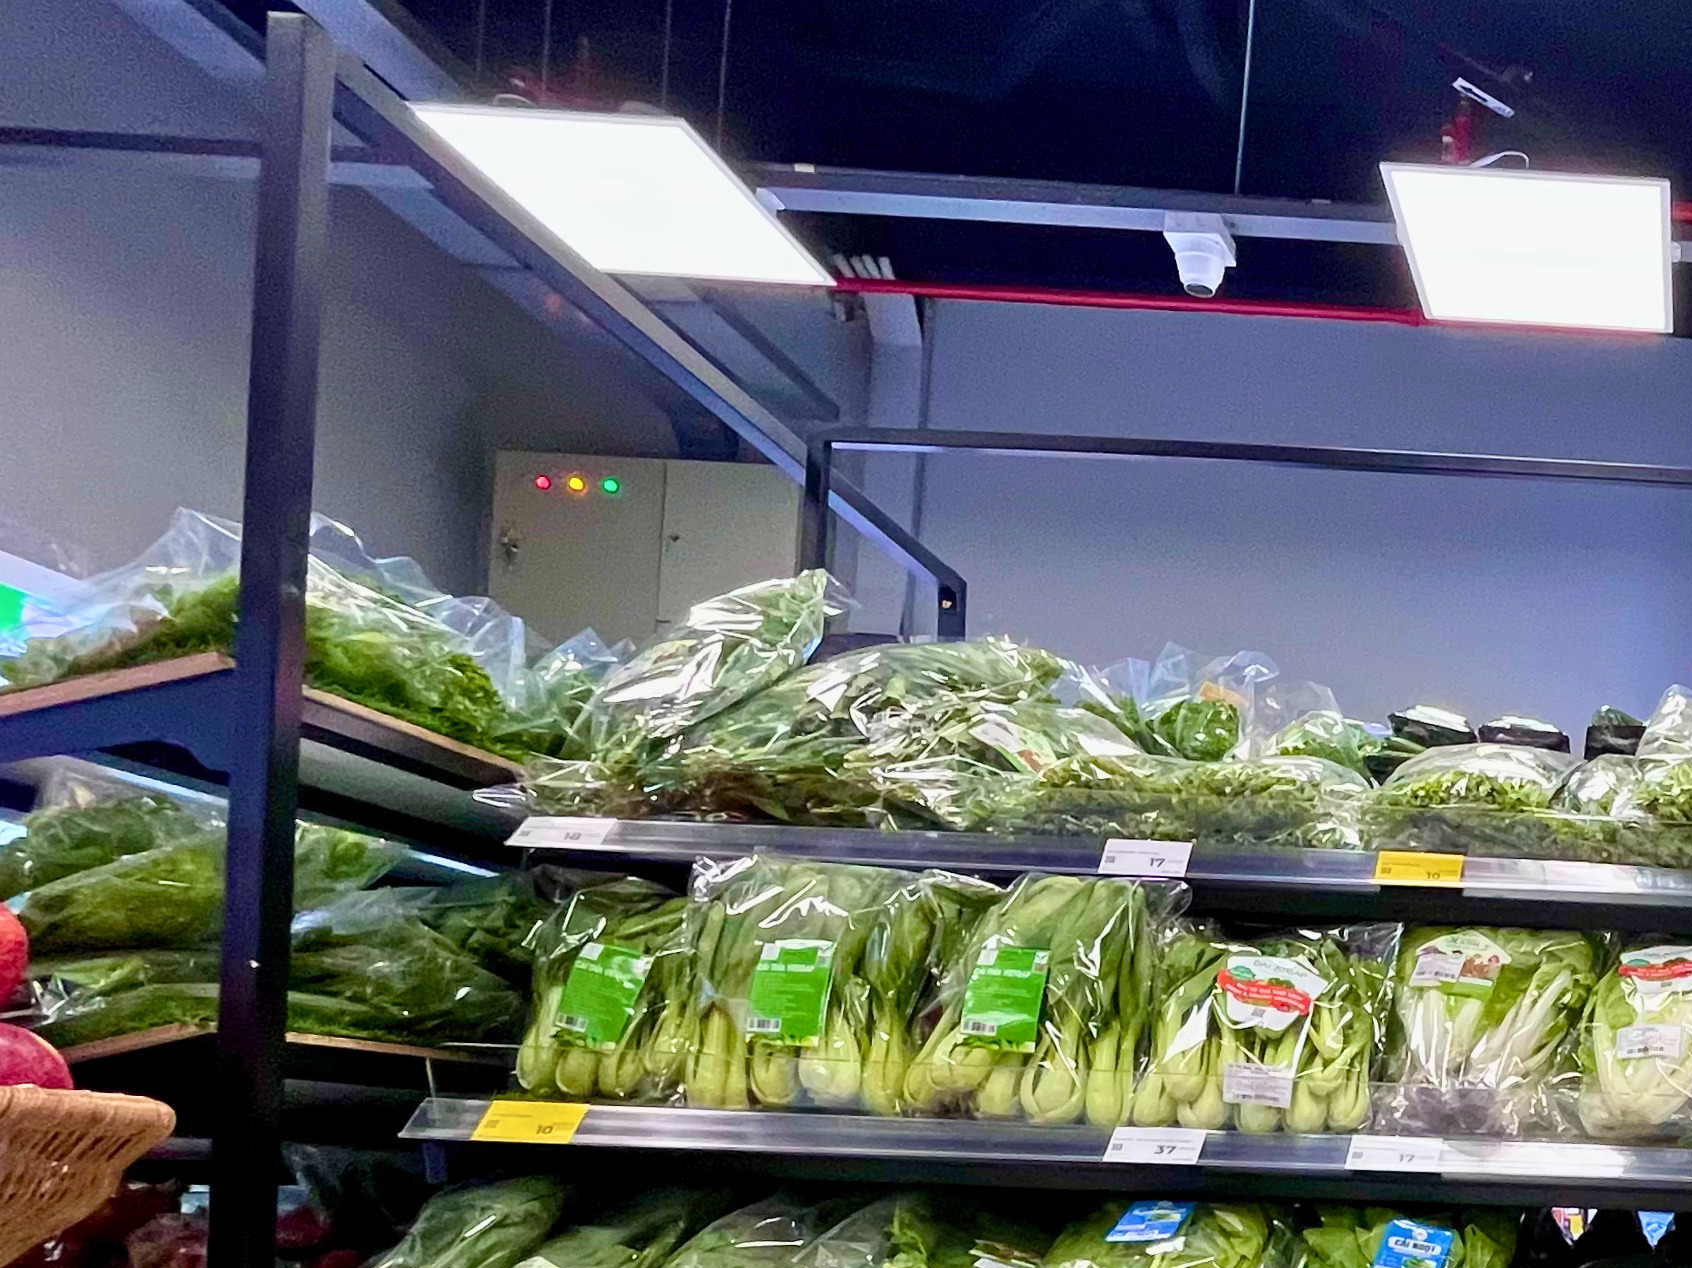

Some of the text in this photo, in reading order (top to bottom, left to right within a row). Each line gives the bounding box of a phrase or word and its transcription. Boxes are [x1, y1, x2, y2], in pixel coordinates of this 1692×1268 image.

[1149, 858, 1166, 868] 17
[536, 1124, 554, 1134] 10
[1154, 1144, 1177, 1156] 37
